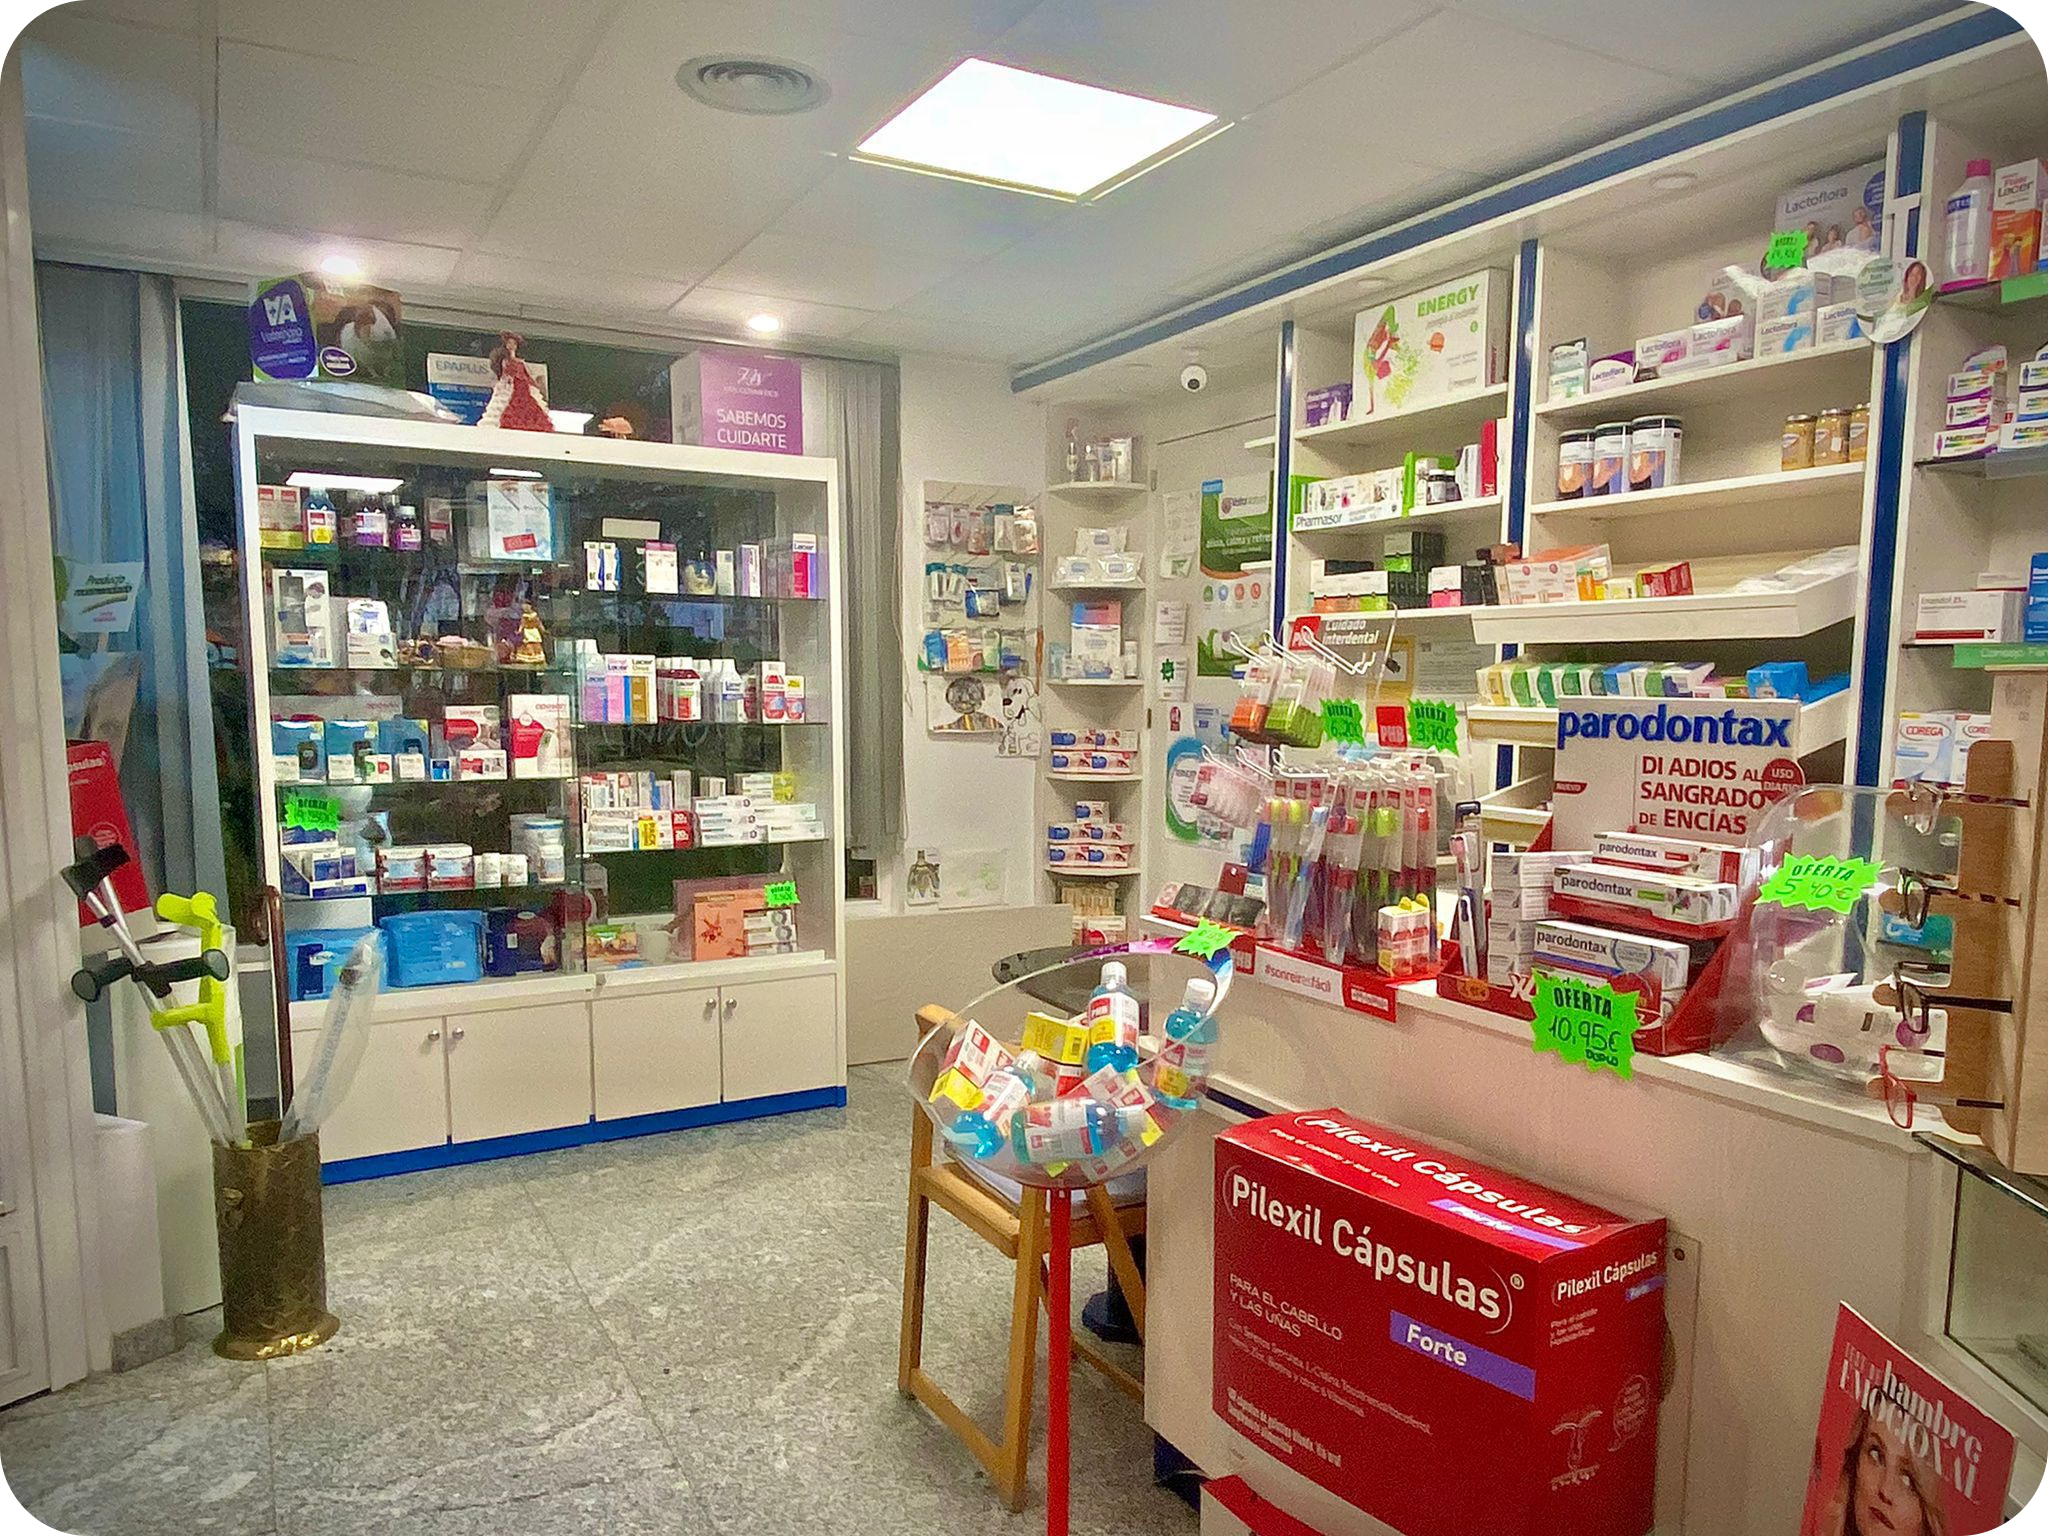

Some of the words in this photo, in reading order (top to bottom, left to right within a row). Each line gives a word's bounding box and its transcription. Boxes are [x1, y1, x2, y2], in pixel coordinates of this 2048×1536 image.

[1785, 187, 1848, 214] Lactoflora
[1997, 181, 2035, 198] Lacer
[1417, 284, 1479, 317] ENERGY
[1824, 308, 1857, 320] Lactoflo
[1641, 340, 1681, 354] Lactoflora
[1693, 327, 1737, 342] Lactoflora
[435, 360, 489, 374] EPAPLUS
[1592, 367, 1626, 381] Lactoflora
[716, 409, 787, 429] SABEMOS
[717, 429, 787, 449] CUIDARTE
[1325, 620, 1367, 632] Cuidado
[1558, 704, 1792, 750] parodontax
[1905, 725, 1944, 737] COREGA
[1642, 756, 1667, 775] DI
[1670, 757, 1738, 780] ADIOS
[1743, 768, 1763, 782] AL
[1771, 768, 1795, 779] USO
[1641, 780, 1766, 811] SANGRADO
[1639, 812, 1658, 826] DE
[1664, 808, 1748, 835] ENCÍAS
[1599, 842, 1658, 858] parodontax
[1792, 864, 1856, 881] OFERTA
[1561, 875, 1633, 897] parodontax
[1536, 930, 1608, 955] parodontax
[1553, 987, 1613, 1020] OFERTA
[1548, 1015, 1622, 1052] 10,95€
[1305, 1119, 1417, 1162] Pilexil
[1412, 1160, 1589, 1235] Cápsulas
[1231, 1174, 1323, 1246] Pilexil
[1333, 1219, 1501, 1320] Cápsulas
[1557, 1269, 1601, 1301] Pilexil
[1603, 1251, 1659, 1283] Cápsulas
[1229, 1273, 1260, 1297] PARA
[1262, 1290, 1279, 1310] EL
[1280, 1300, 1344, 1341] CABELLO
[1229, 1290, 1238, 1303] Y
[1239, 1297, 1264, 1318] LAS
[1264, 1309, 1302, 1338] UÑAS
[1406, 1323, 1469, 1368] Forte
[1883, 1360, 1982, 1463] hambre
